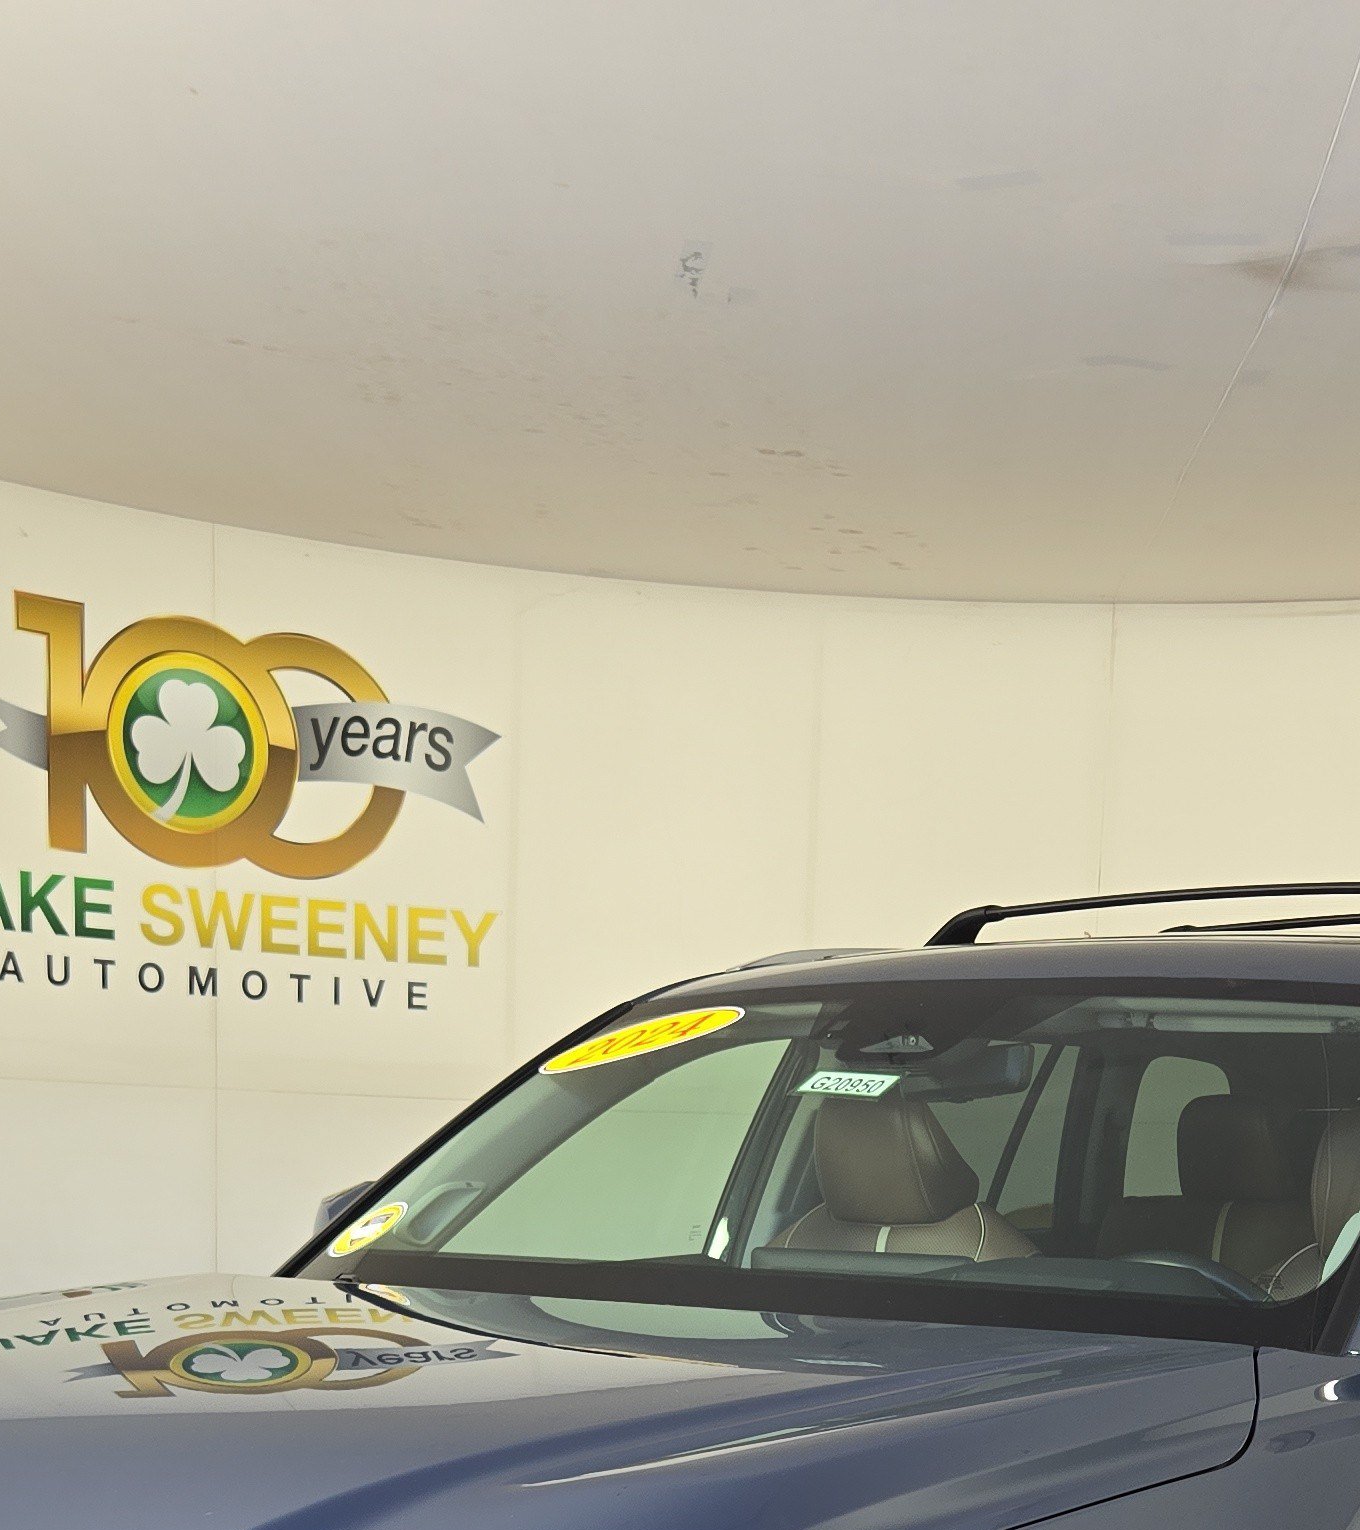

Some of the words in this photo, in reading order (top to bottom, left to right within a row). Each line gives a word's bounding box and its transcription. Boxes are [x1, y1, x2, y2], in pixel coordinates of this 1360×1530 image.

[13, 589, 406, 880] 100
[310, 714, 454, 773] years
[140, 884, 500, 968] SWEENEY
[566, 1013, 716, 1066] 2024
[811, 1077, 885, 1093] G20950
